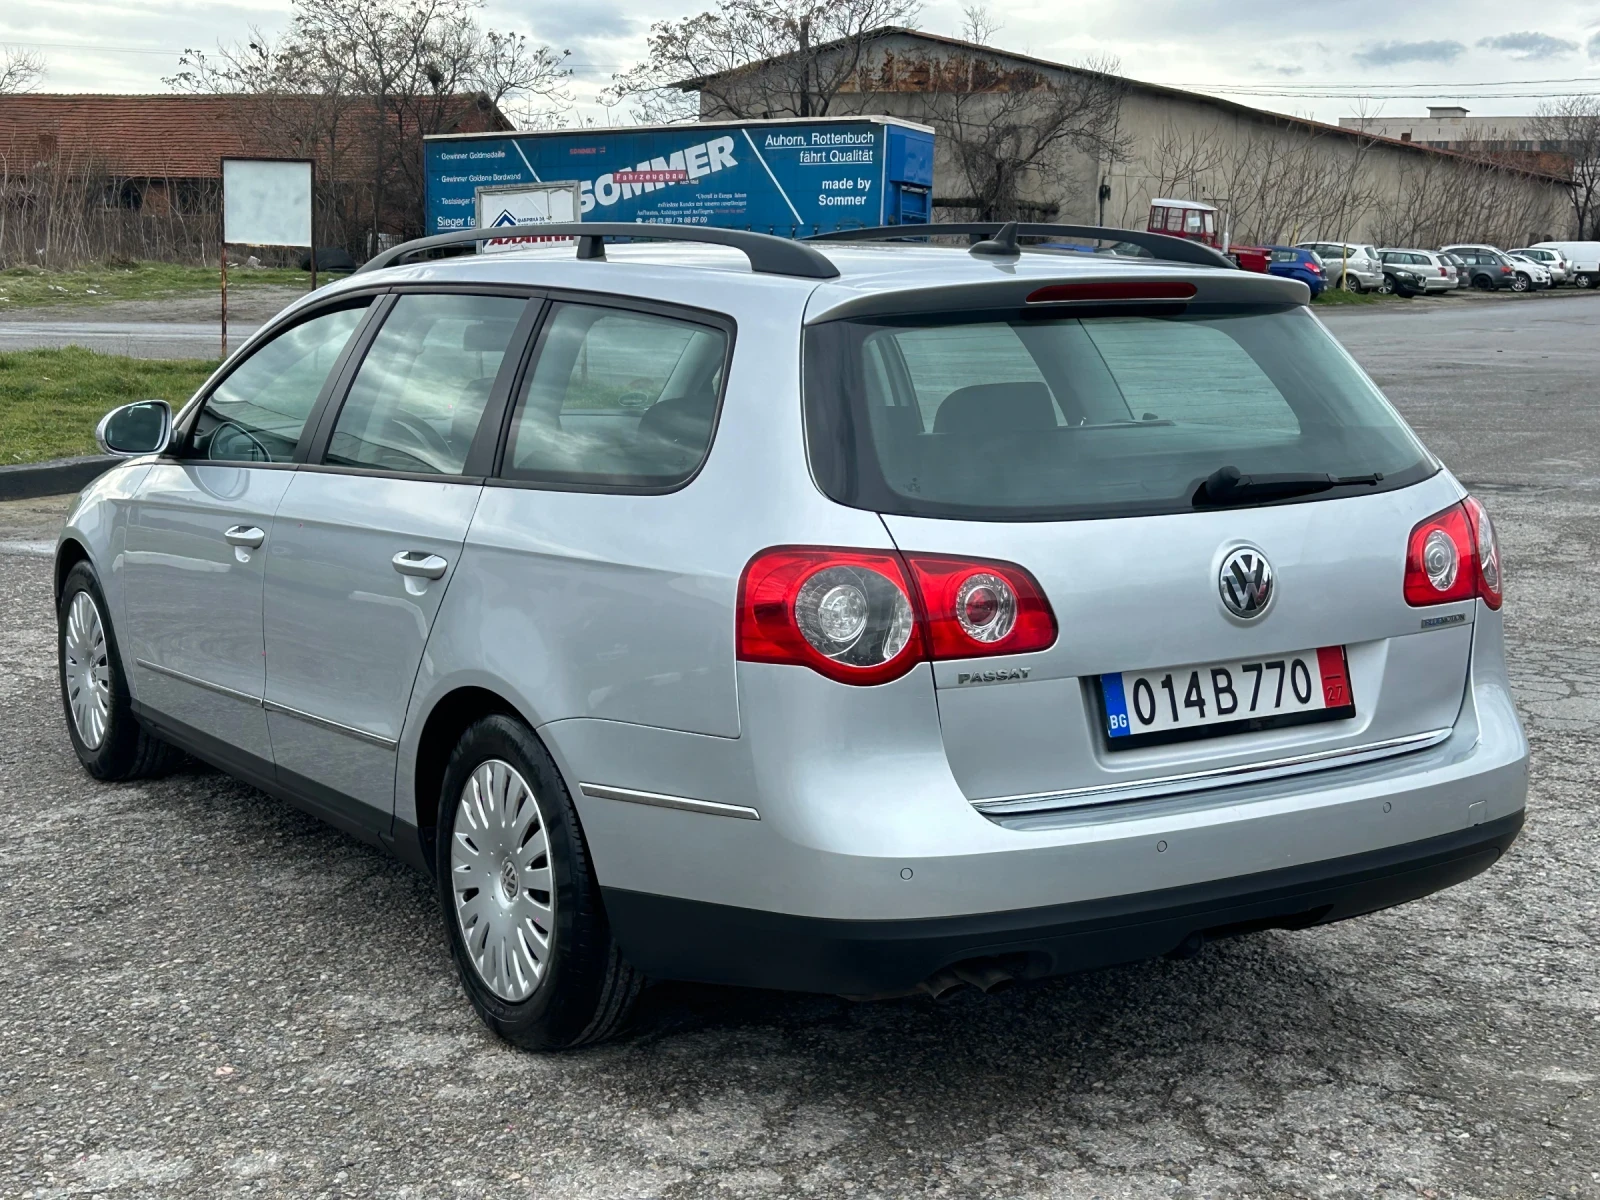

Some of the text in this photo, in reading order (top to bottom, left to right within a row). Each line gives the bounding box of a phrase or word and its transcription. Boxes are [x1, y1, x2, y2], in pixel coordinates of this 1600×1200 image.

[765, 132, 874, 146] Auhorn, Rottenbuch
[800, 150, 873, 163] fährt Qualität
[580, 136, 738, 213] SOMMER
[615, 171, 685, 182] Fahrzeugbau
[822, 178, 871, 192] made by
[818, 195, 867, 206] Sommer
[437, 216, 465, 228] Sieger
[958, 667, 1031, 685] PASSAT
[1132, 658, 1312, 726] 014B770
[1326, 684, 1343, 702] 27
[1109, 713, 1128, 730] BG
